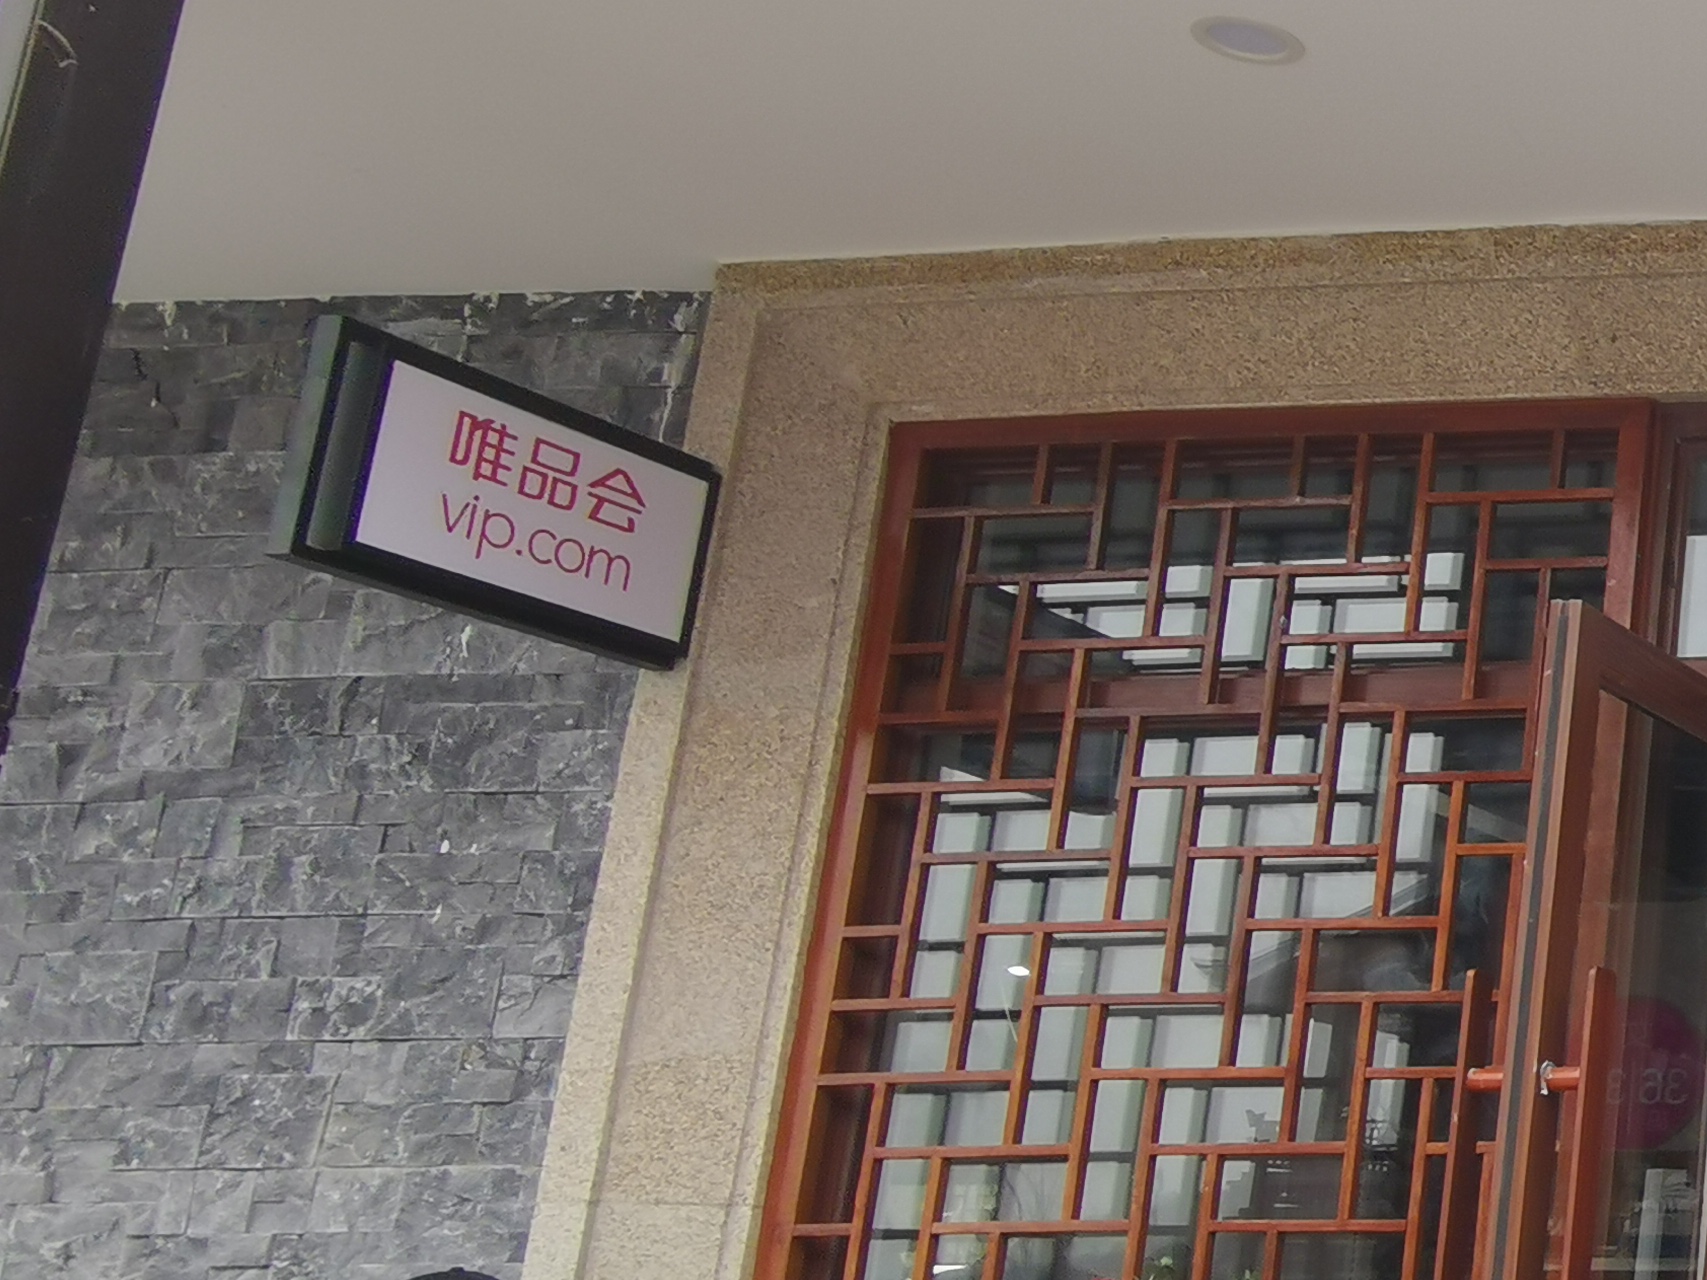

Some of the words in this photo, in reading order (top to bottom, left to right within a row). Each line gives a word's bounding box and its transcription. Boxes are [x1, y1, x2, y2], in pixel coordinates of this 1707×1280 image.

[448, 410, 646, 533] 唯品会
[441, 492, 631, 591] vip.com
